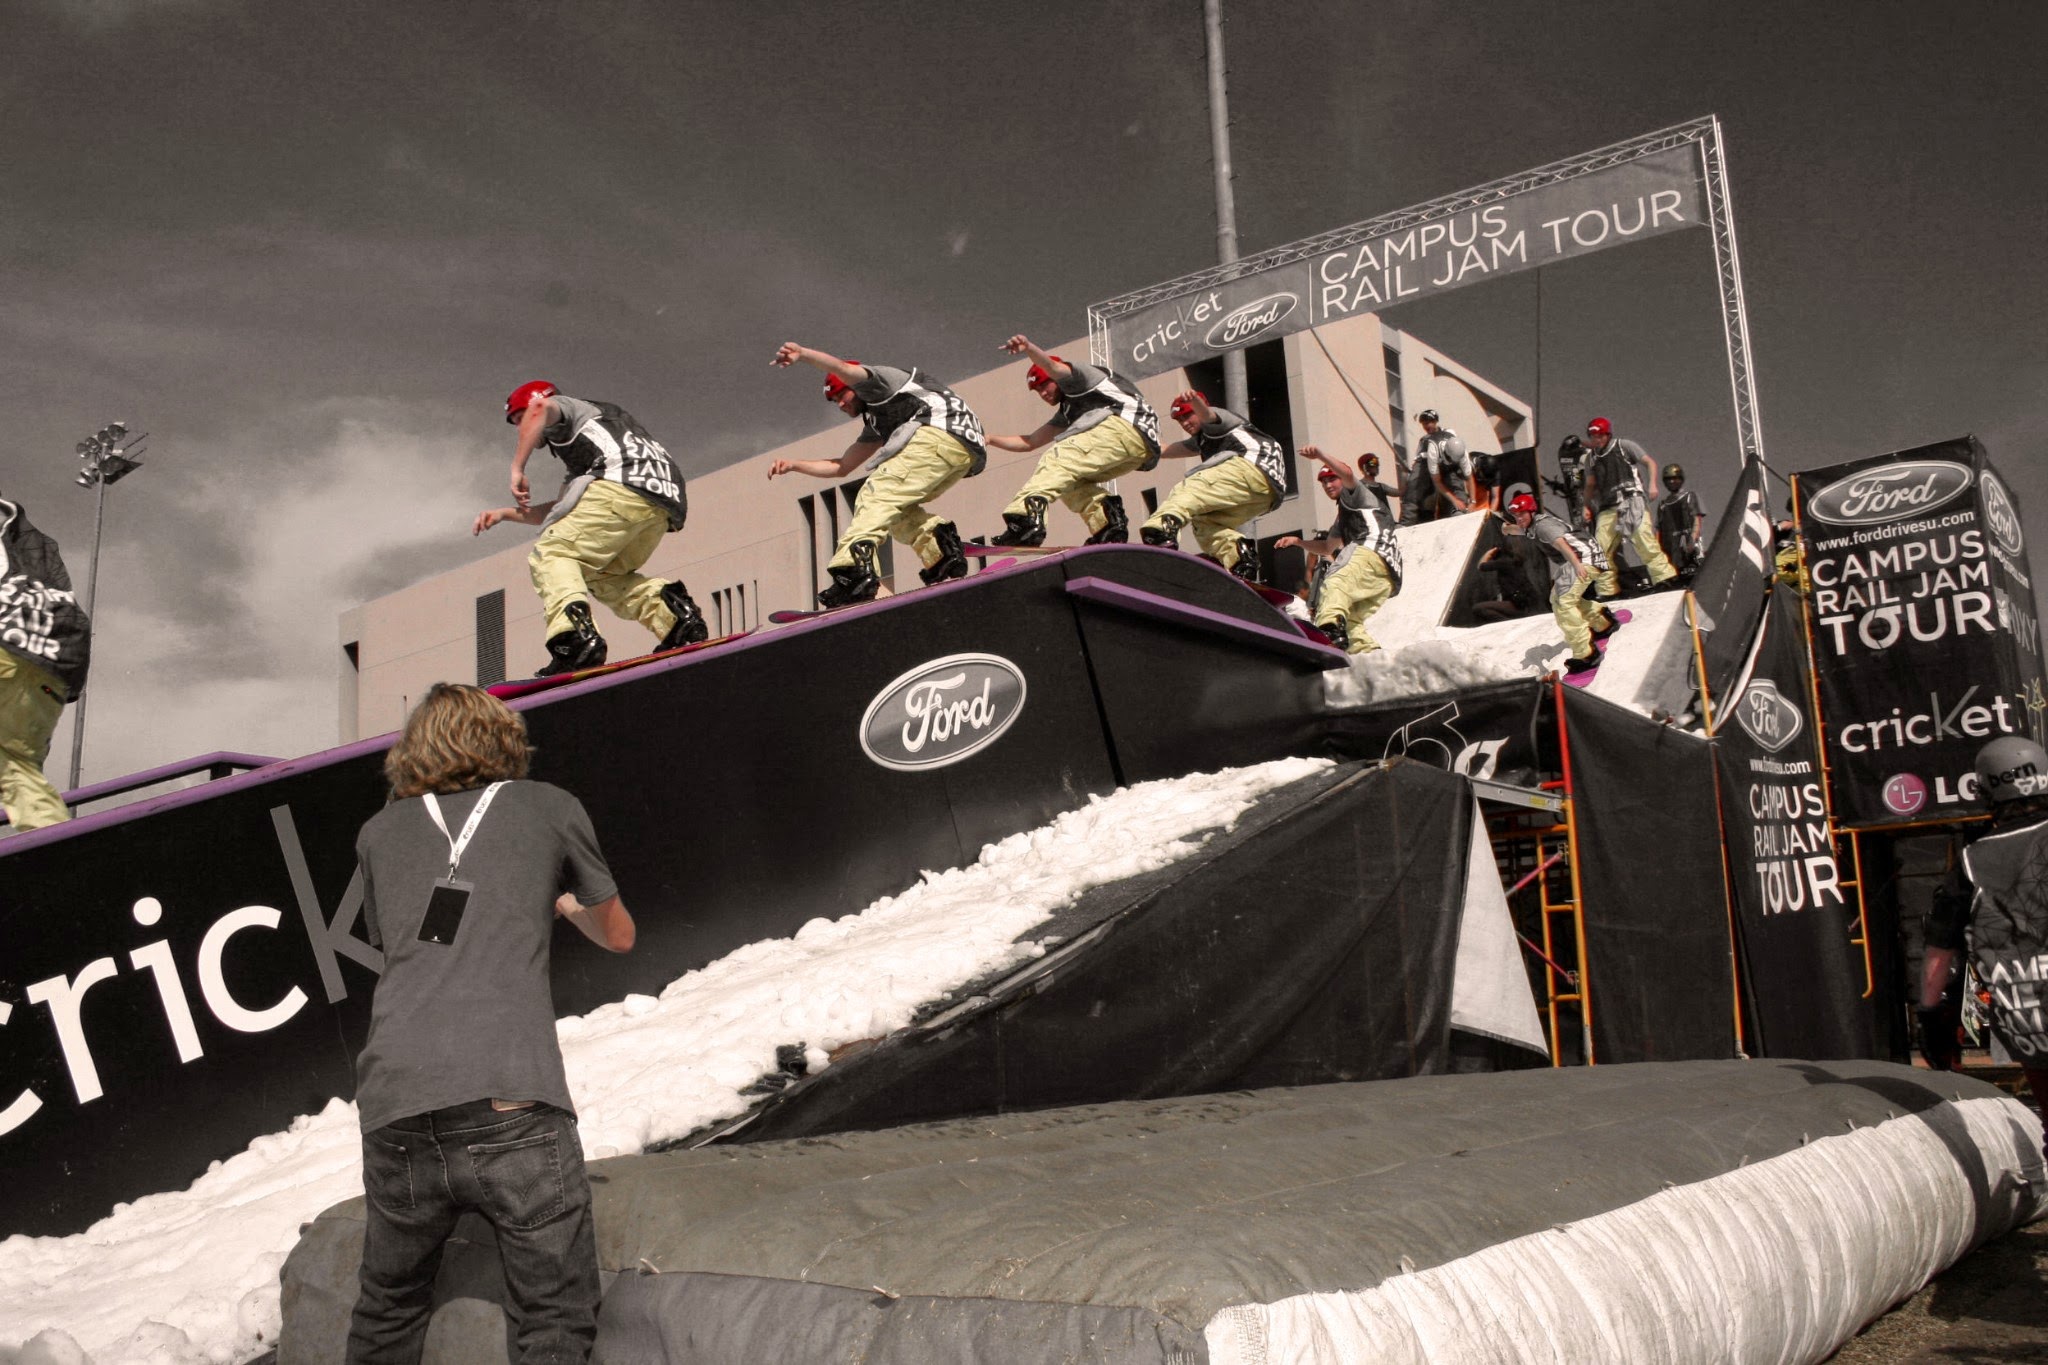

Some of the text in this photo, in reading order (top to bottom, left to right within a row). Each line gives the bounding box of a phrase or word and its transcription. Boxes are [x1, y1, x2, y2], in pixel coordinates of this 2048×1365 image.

[1320, 205, 1508, 284] CAMPUS
[1322, 190, 1686, 318] RAIL JAM TOUR
[1223, 302, 1280, 343] Ford
[628, 477, 680, 503] TOUR
[1840, 470, 1939, 517] Ford
[1816, 511, 1975, 552] www.forddrivesu.com
[1811, 530, 1985, 587] CAMPUS
[1816, 579, 1900, 615] RAIL
[1911, 561, 1990, 598] JAM
[1819, 590, 1996, 656] TOUR
[902, 672, 996, 753] Ford
[1987, 762, 2037, 788] bern
[1750, 783, 1825, 819] CAMPUS
[1754, 821, 1834, 857] RAIL JAM
[1756, 855, 1844, 916] TOUR
